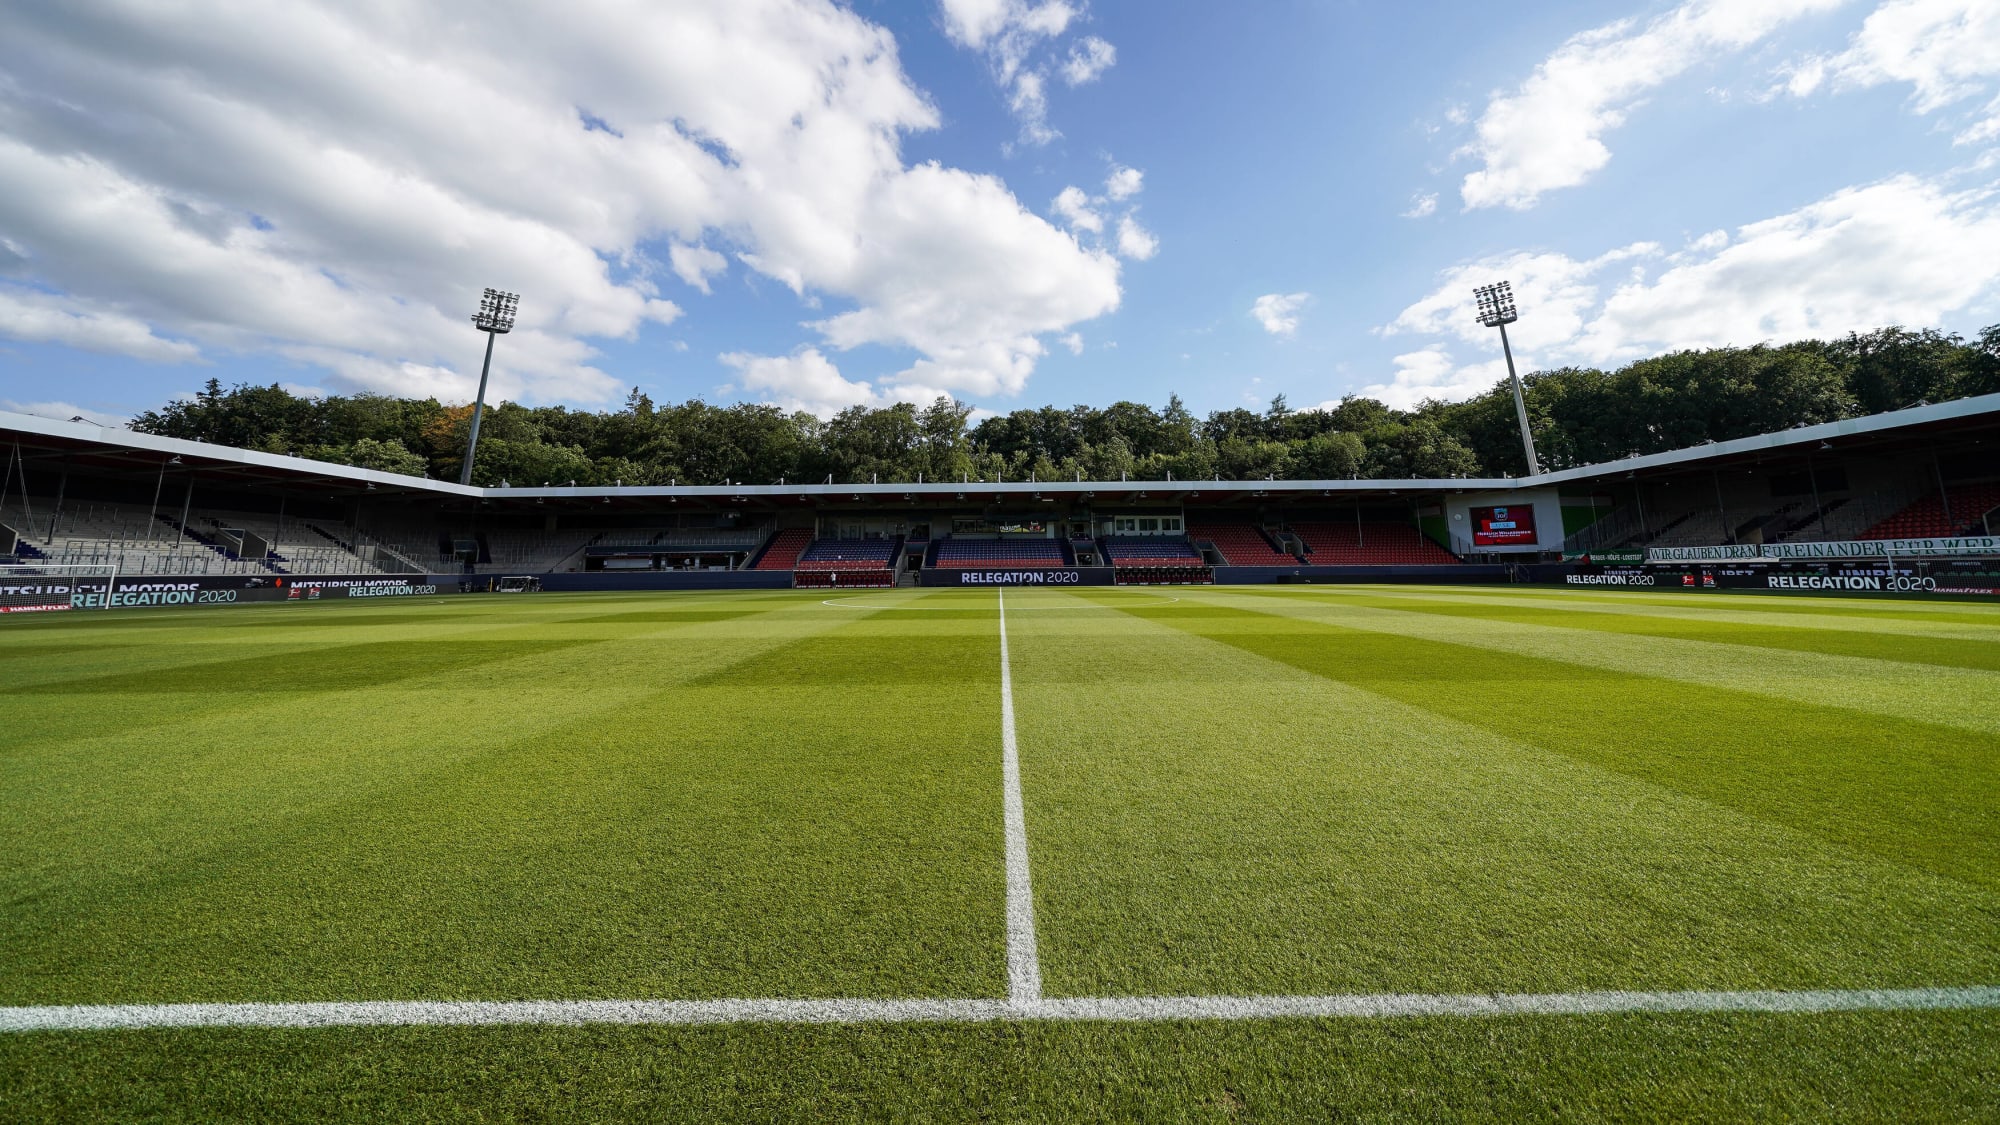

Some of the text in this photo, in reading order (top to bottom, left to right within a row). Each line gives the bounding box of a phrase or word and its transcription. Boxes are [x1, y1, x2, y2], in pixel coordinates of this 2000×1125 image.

[1650, 545, 1756, 560] WIR GLAUBEN DRAN
[1761, 541, 1888, 558] FÜREINANDER
[1942, 538, 2000, 554] WER
[962, 571, 1079, 583] RELEGATION 2020
[1567, 575, 1655, 585] RELEGATION 2020
[1768, 576, 1936, 590] RELEGATION 2020
[349, 585, 436, 597] RELEGATION 2020
[71, 589, 237, 608] RELEGATION 2020
